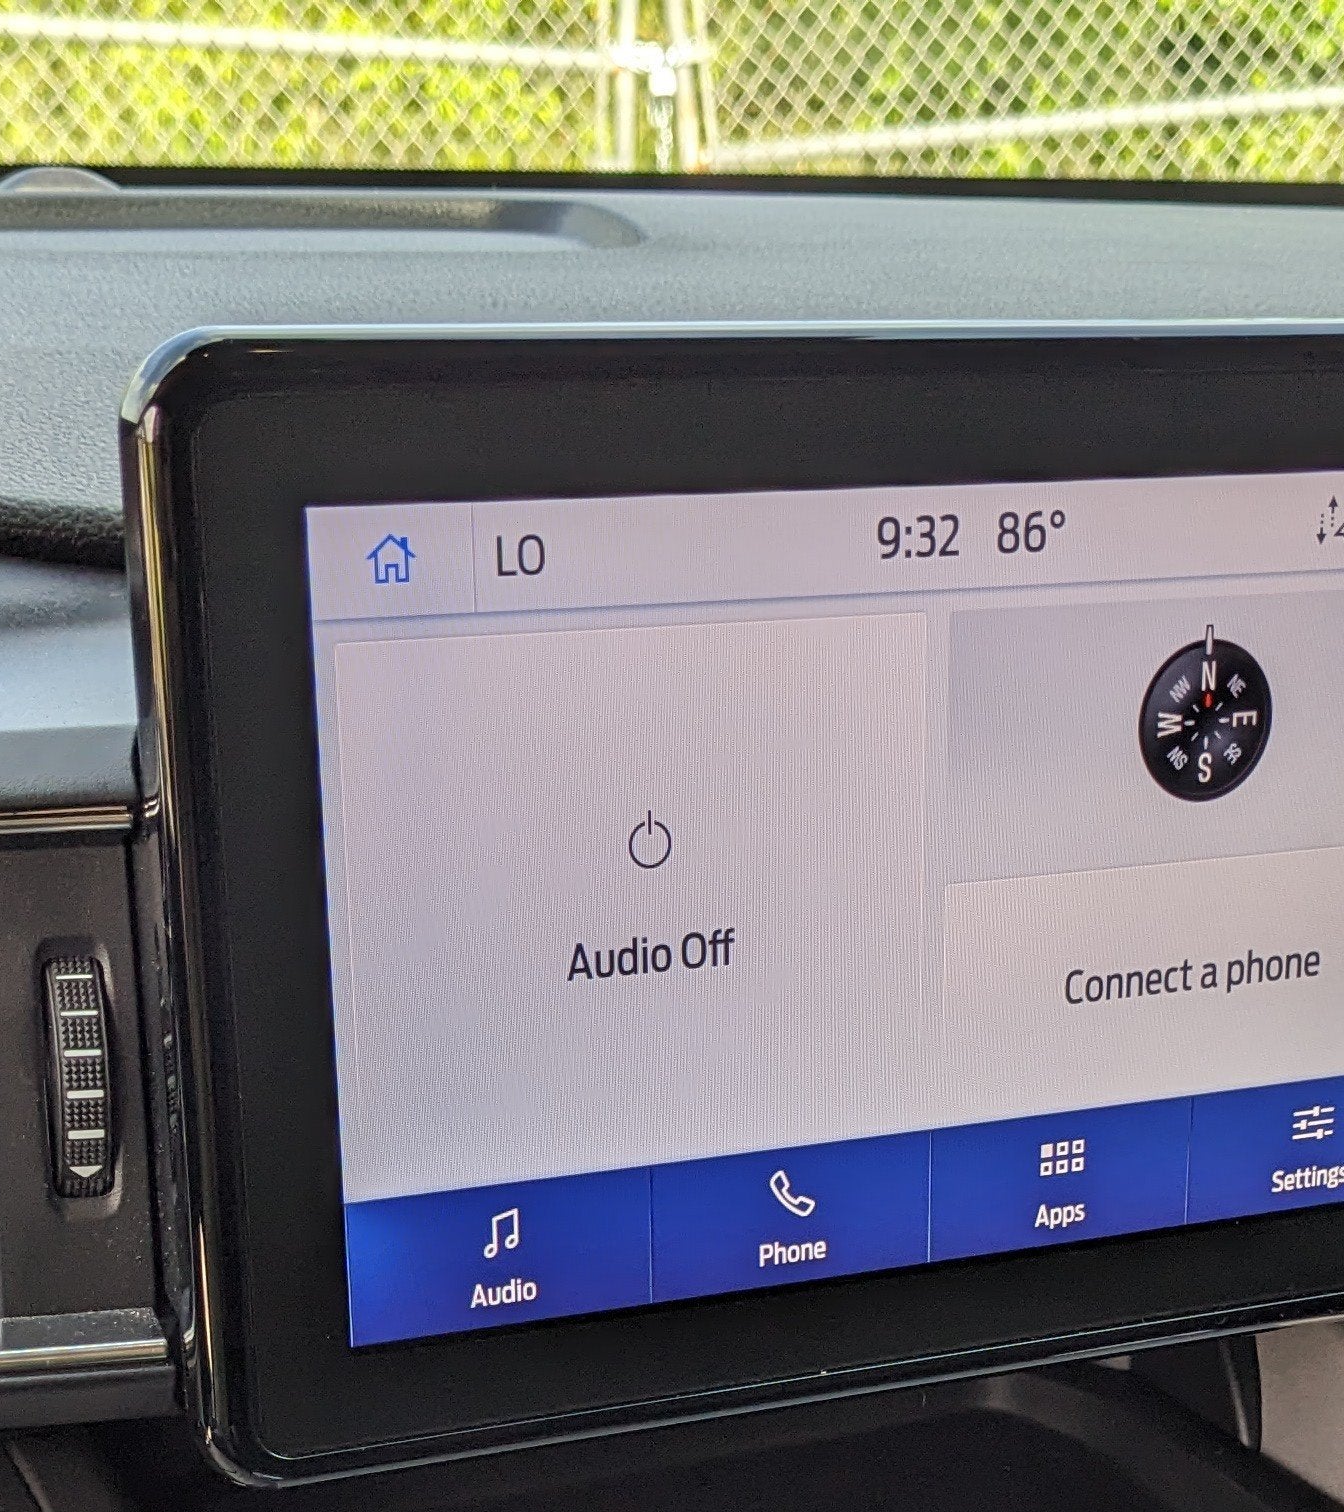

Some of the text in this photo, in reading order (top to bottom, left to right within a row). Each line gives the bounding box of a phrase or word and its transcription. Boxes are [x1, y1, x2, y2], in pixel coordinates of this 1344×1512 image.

[876, 509, 1066, 559] 9:32 86°
[496, 534, 546, 577] LO
[1201, 660, 1217, 692] N
[1157, 711, 1183, 739] W
[1232, 710, 1257, 728] E
[1197, 752, 1212, 783] S
[566, 927, 736, 982] Audio Off
[1064, 949, 1321, 1005] Connect a phone
[1034, 1202, 1086, 1230] Apps
[758, 1237, 828, 1269] Phone
[469, 1277, 538, 1310] Audio
